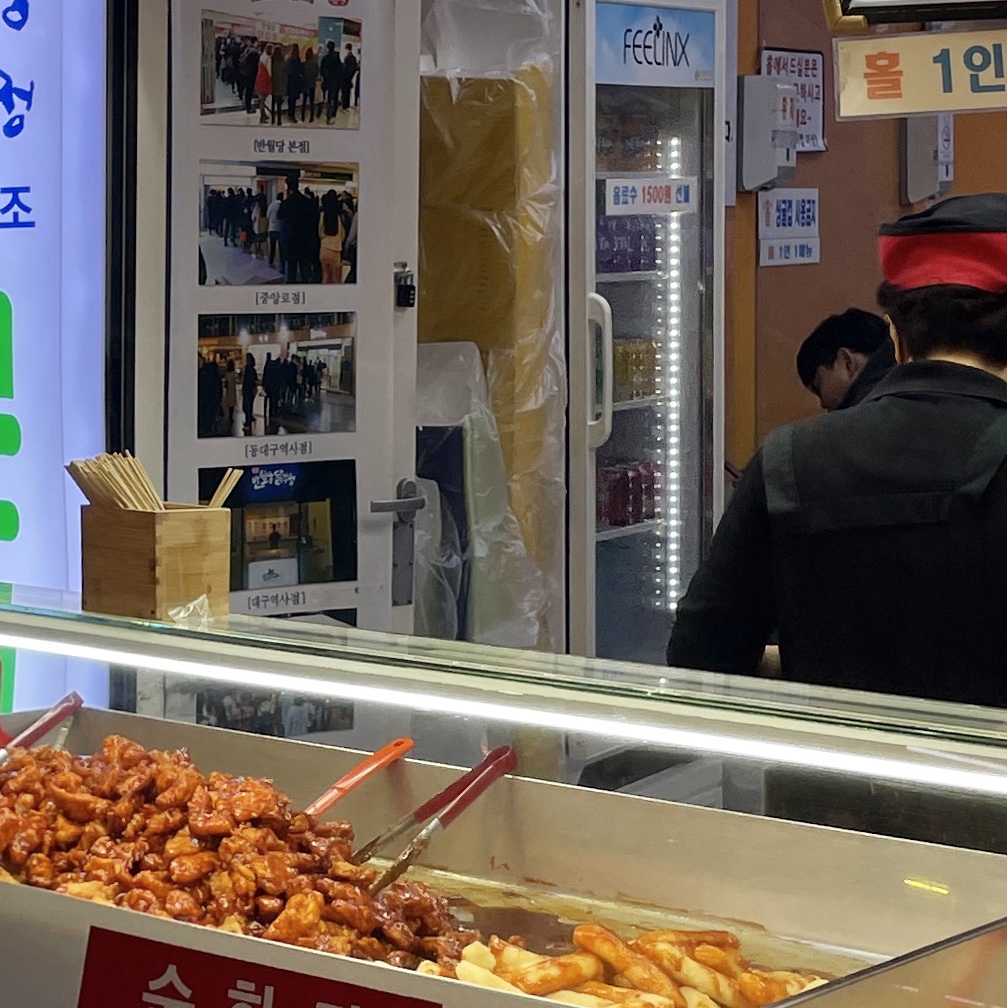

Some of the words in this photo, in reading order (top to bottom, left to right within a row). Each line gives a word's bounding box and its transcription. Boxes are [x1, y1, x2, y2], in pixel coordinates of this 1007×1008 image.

[863, 51, 903, 99] 홀
[933, 43, 1006, 93] 1인
[613, 185, 637, 205] 음료수
[642, 184, 672, 204] 1500원
